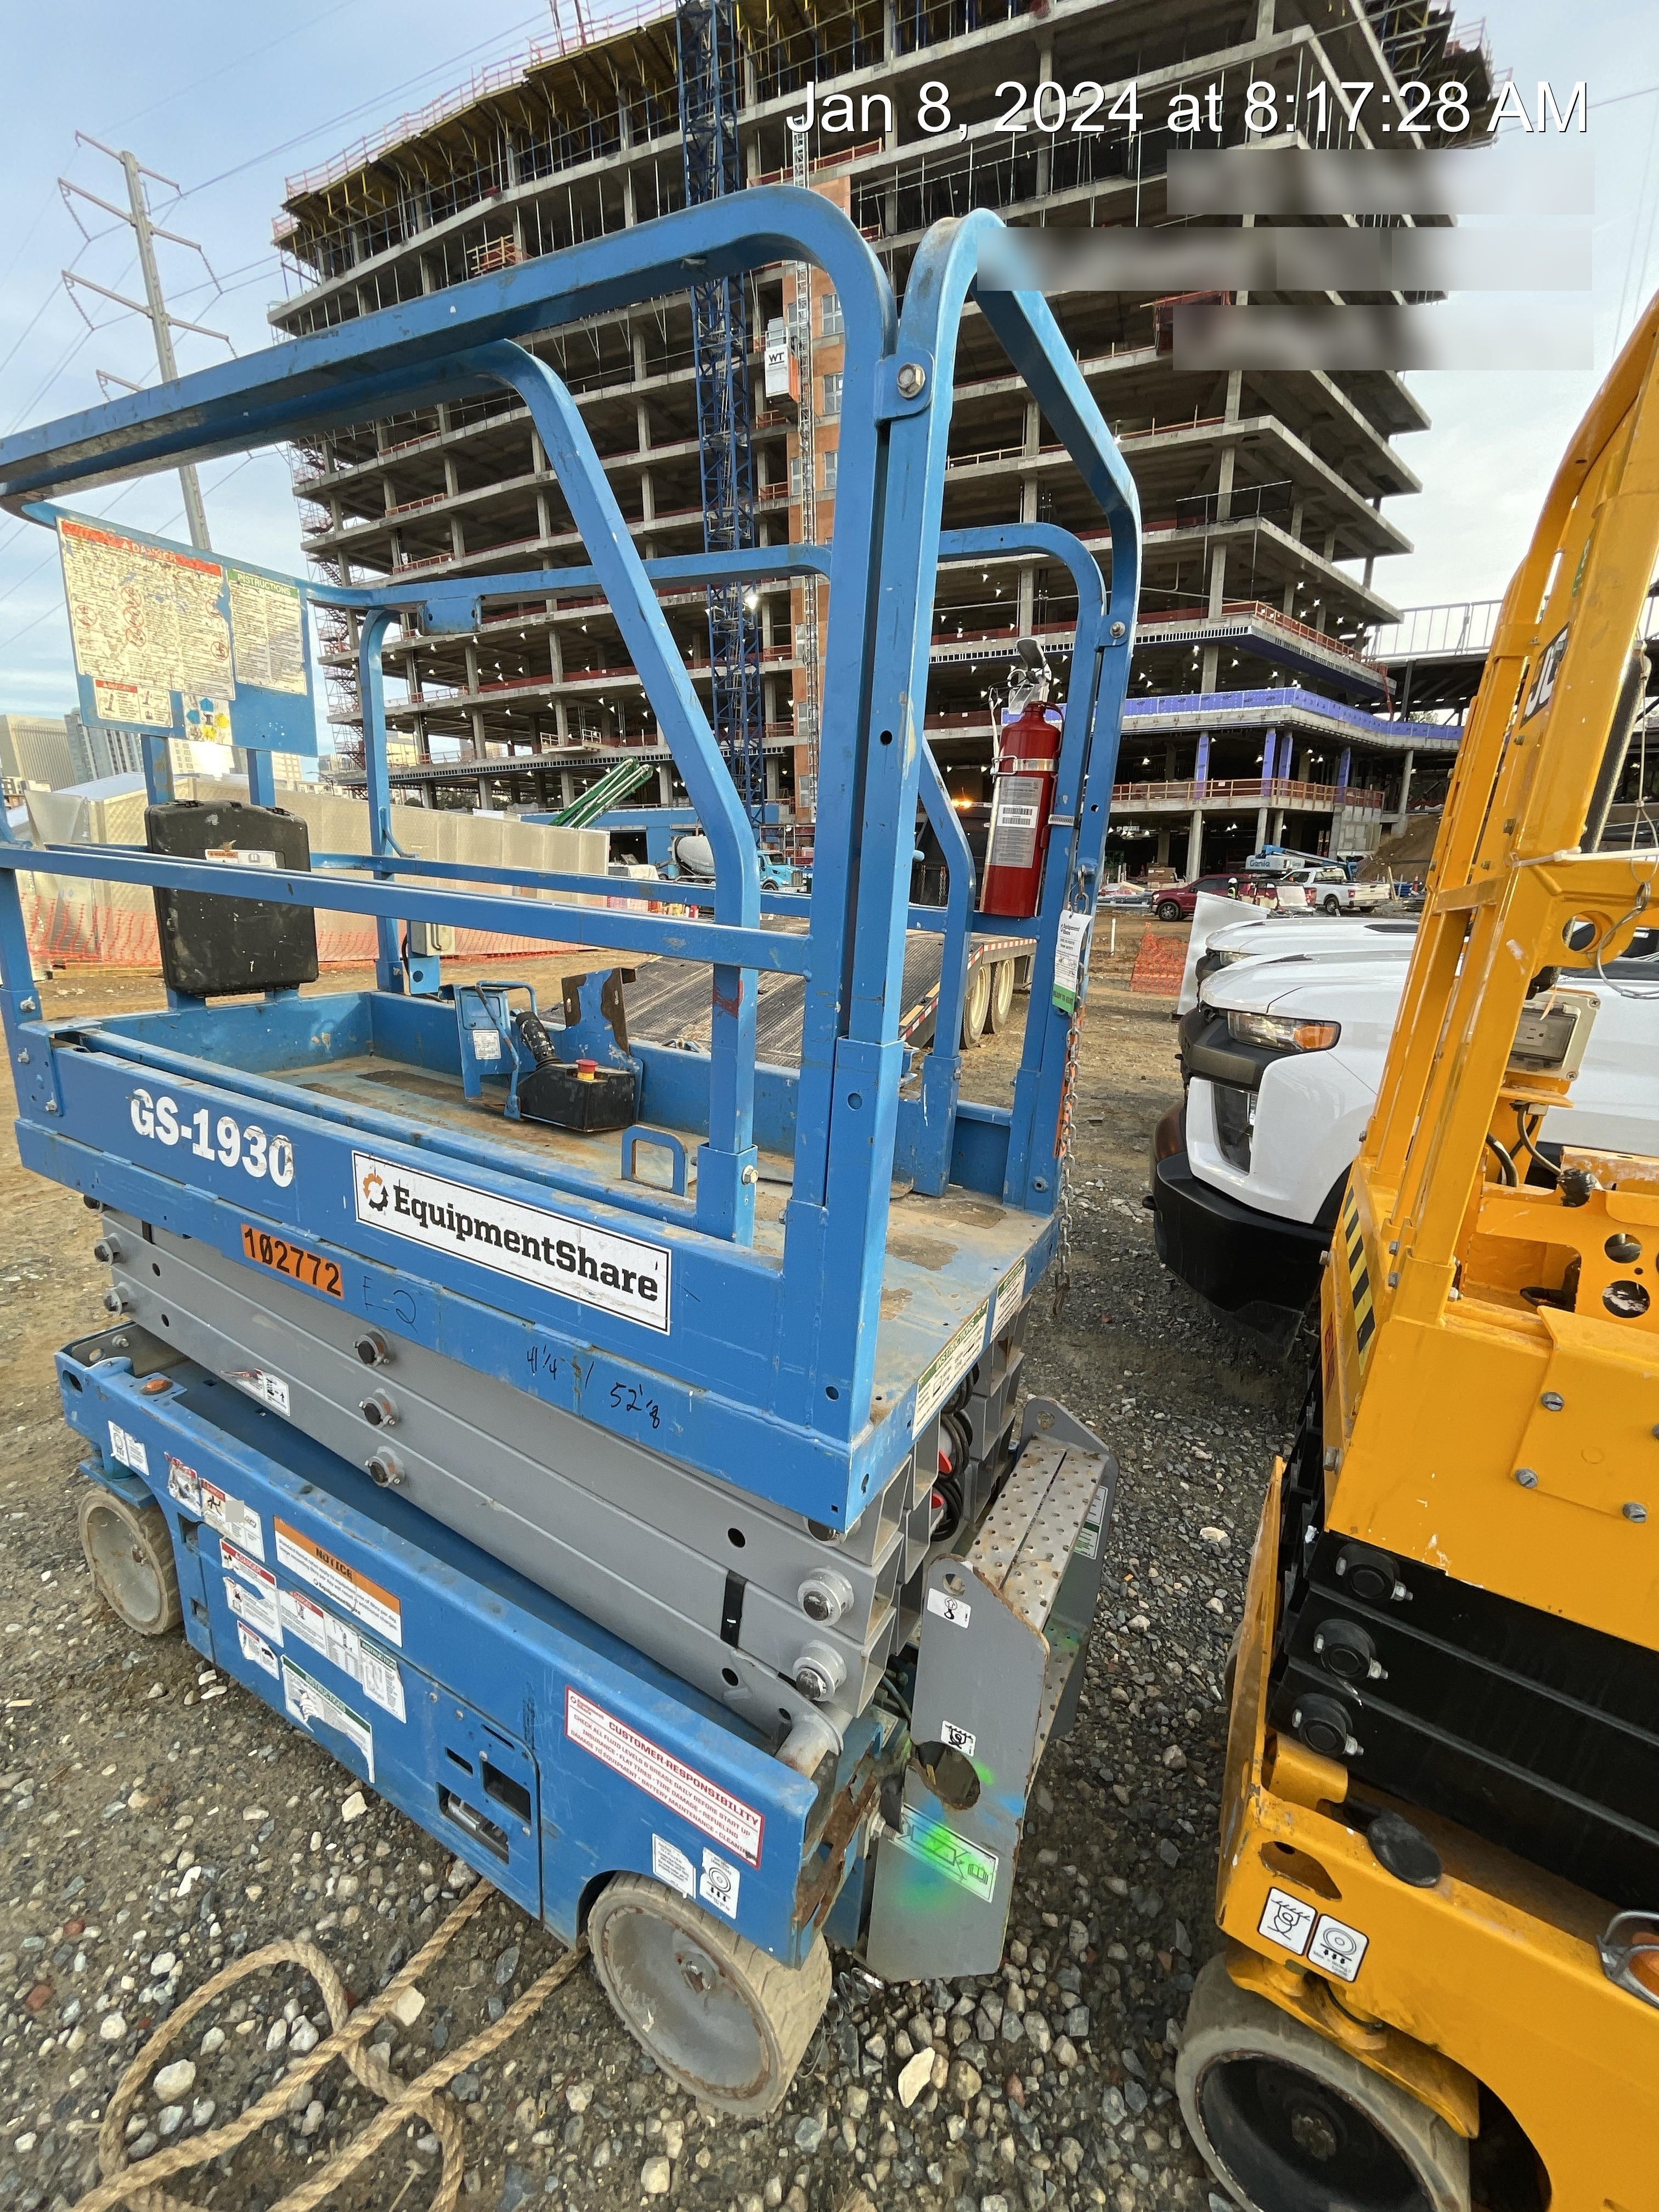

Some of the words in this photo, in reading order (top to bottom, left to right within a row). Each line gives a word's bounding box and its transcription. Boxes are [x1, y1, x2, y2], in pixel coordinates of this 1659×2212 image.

[769, 352, 785, 363] WT
[238, 573, 291, 596] INSTRUCTIONS
[130, 1088, 295, 1187] GS-1930
[244, 1227, 341, 1296] 102772
[393, 1184, 658, 1302] EquipmentShare
[315, 1546, 352, 1580] NOTICE
[571, 1729, 594, 1750] DAMAGE
[603, 1751, 637, 1780] EQUIPMENT
[641, 1778, 668, 1801] BATTERY
[668, 1796, 714, 1833] MAINTENANCE
[573, 1713, 592, 1731] CHECK
[592, 1726, 603, 1738] ALL
[622, 1746, 642, 1765] LEVELS
[674, 1781, 692, 1798] DAILY
[693, 1794, 718, 1816] BEFORE
[719, 1812, 740, 1831] START
[741, 1826, 751, 1838] UP
[582, 1728, 615, 1756] INSURANCE
[619, 1753, 633, 1768] FLAT
[656, 1779, 670, 1793] TIRE
[671, 1789, 698, 1812] DAMAGE
[702, 1810, 738, 1840] REFUELING
[608, 1720, 663, 1764] CUSTOMER
[665, 1758, 759, 1827] RESPONSIBILITY
